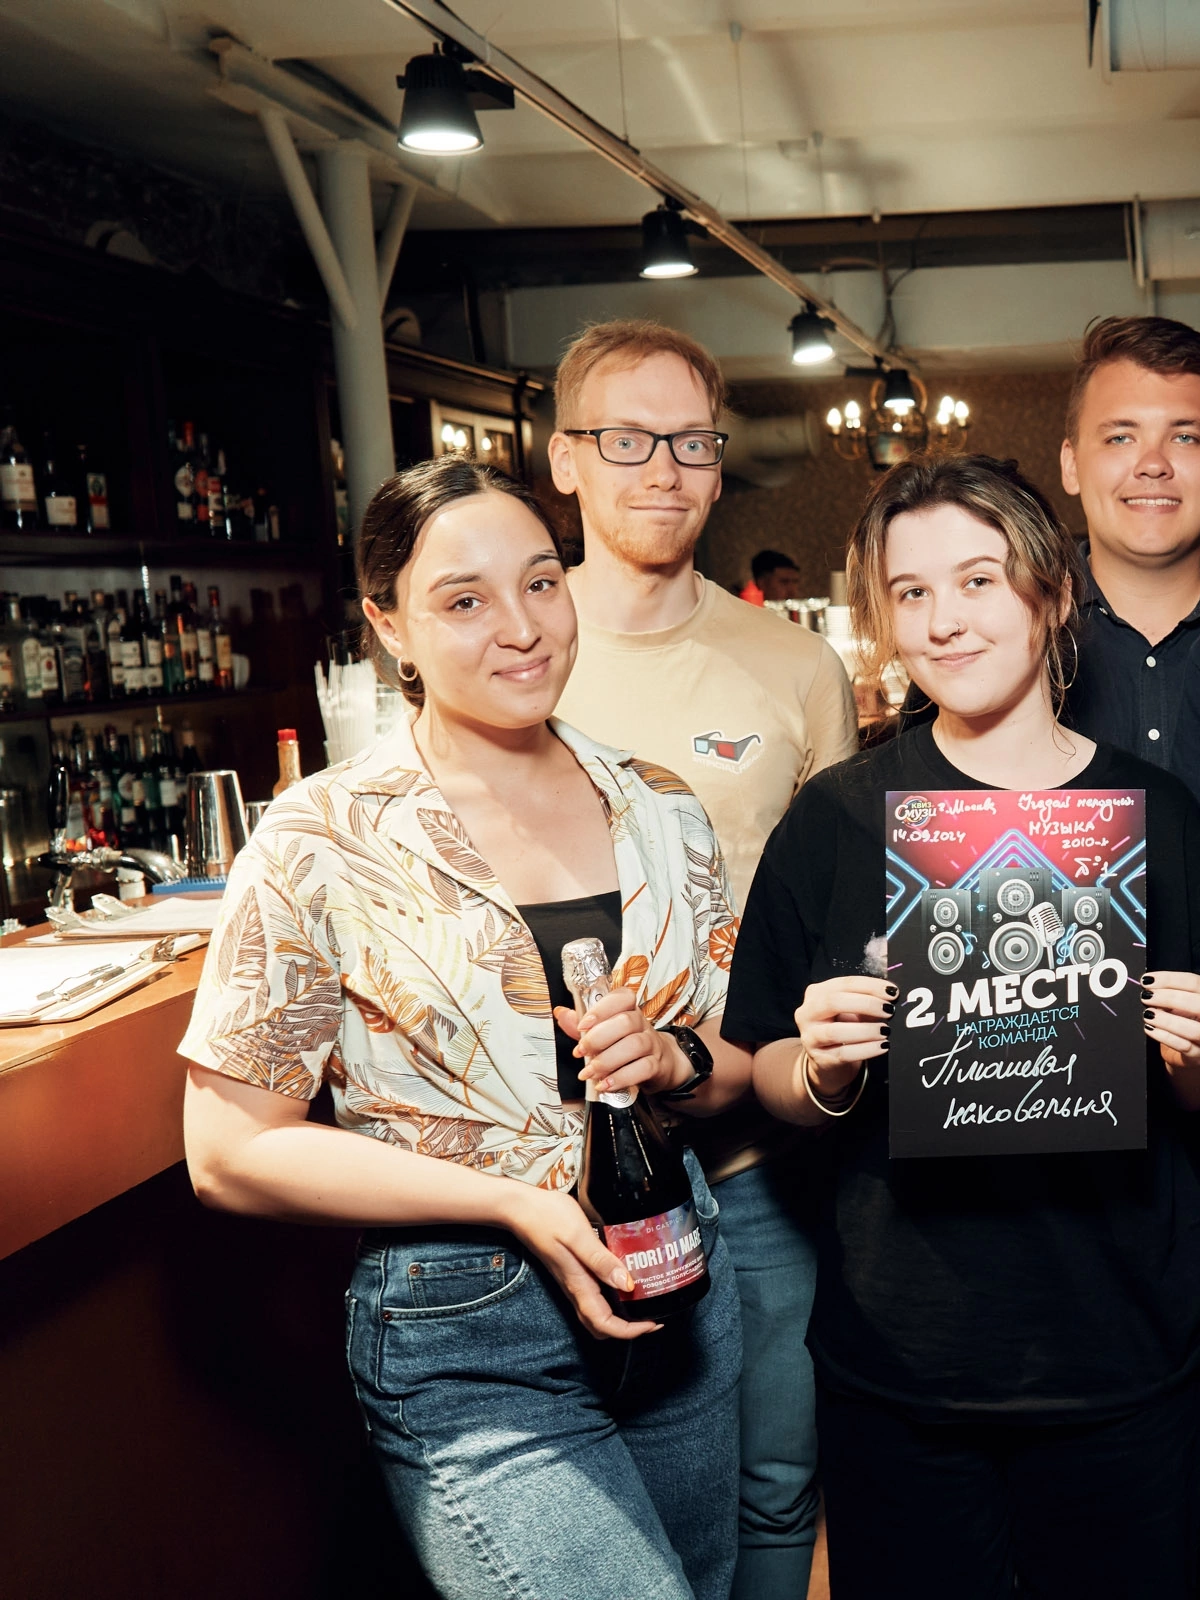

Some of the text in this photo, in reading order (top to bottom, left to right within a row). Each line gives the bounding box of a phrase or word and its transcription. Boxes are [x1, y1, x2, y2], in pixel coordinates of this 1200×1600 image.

[895, 804, 937, 821] Смузи
[893, 829, 966, 843] 14.09.2024
[906, 958, 1128, 1028] 2 МЕСТО
[956, 1005, 1080, 1036] НАГРАЖДАЕТСЯ
[978, 1025, 1058, 1049] КОМАНДА
[626, 1247, 663, 1271] FIORI
[664, 1241, 680, 1261] DI
